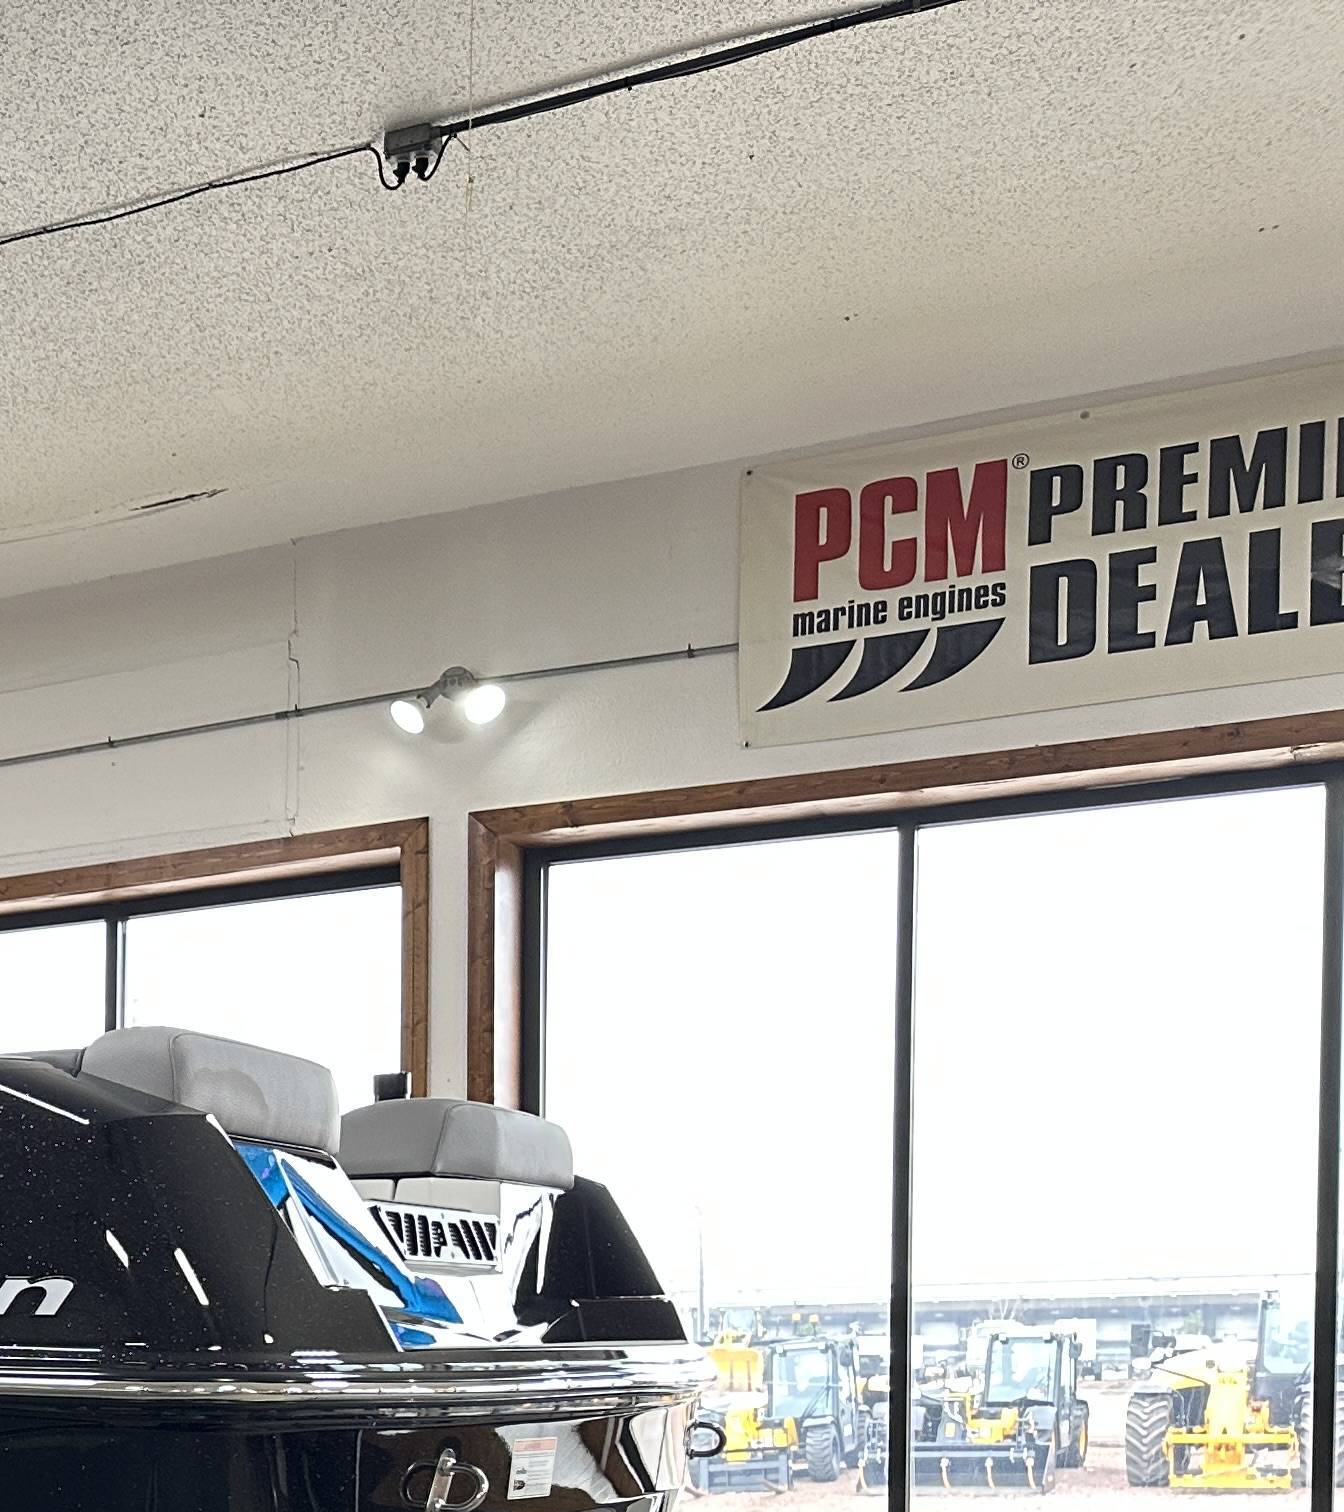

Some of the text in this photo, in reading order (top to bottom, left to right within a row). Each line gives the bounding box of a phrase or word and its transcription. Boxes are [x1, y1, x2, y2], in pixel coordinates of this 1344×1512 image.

[792, 459, 1008, 603] PCM
[1028, 417, 1344, 546] PREMI
[792, 582, 1007, 637] marine engines
